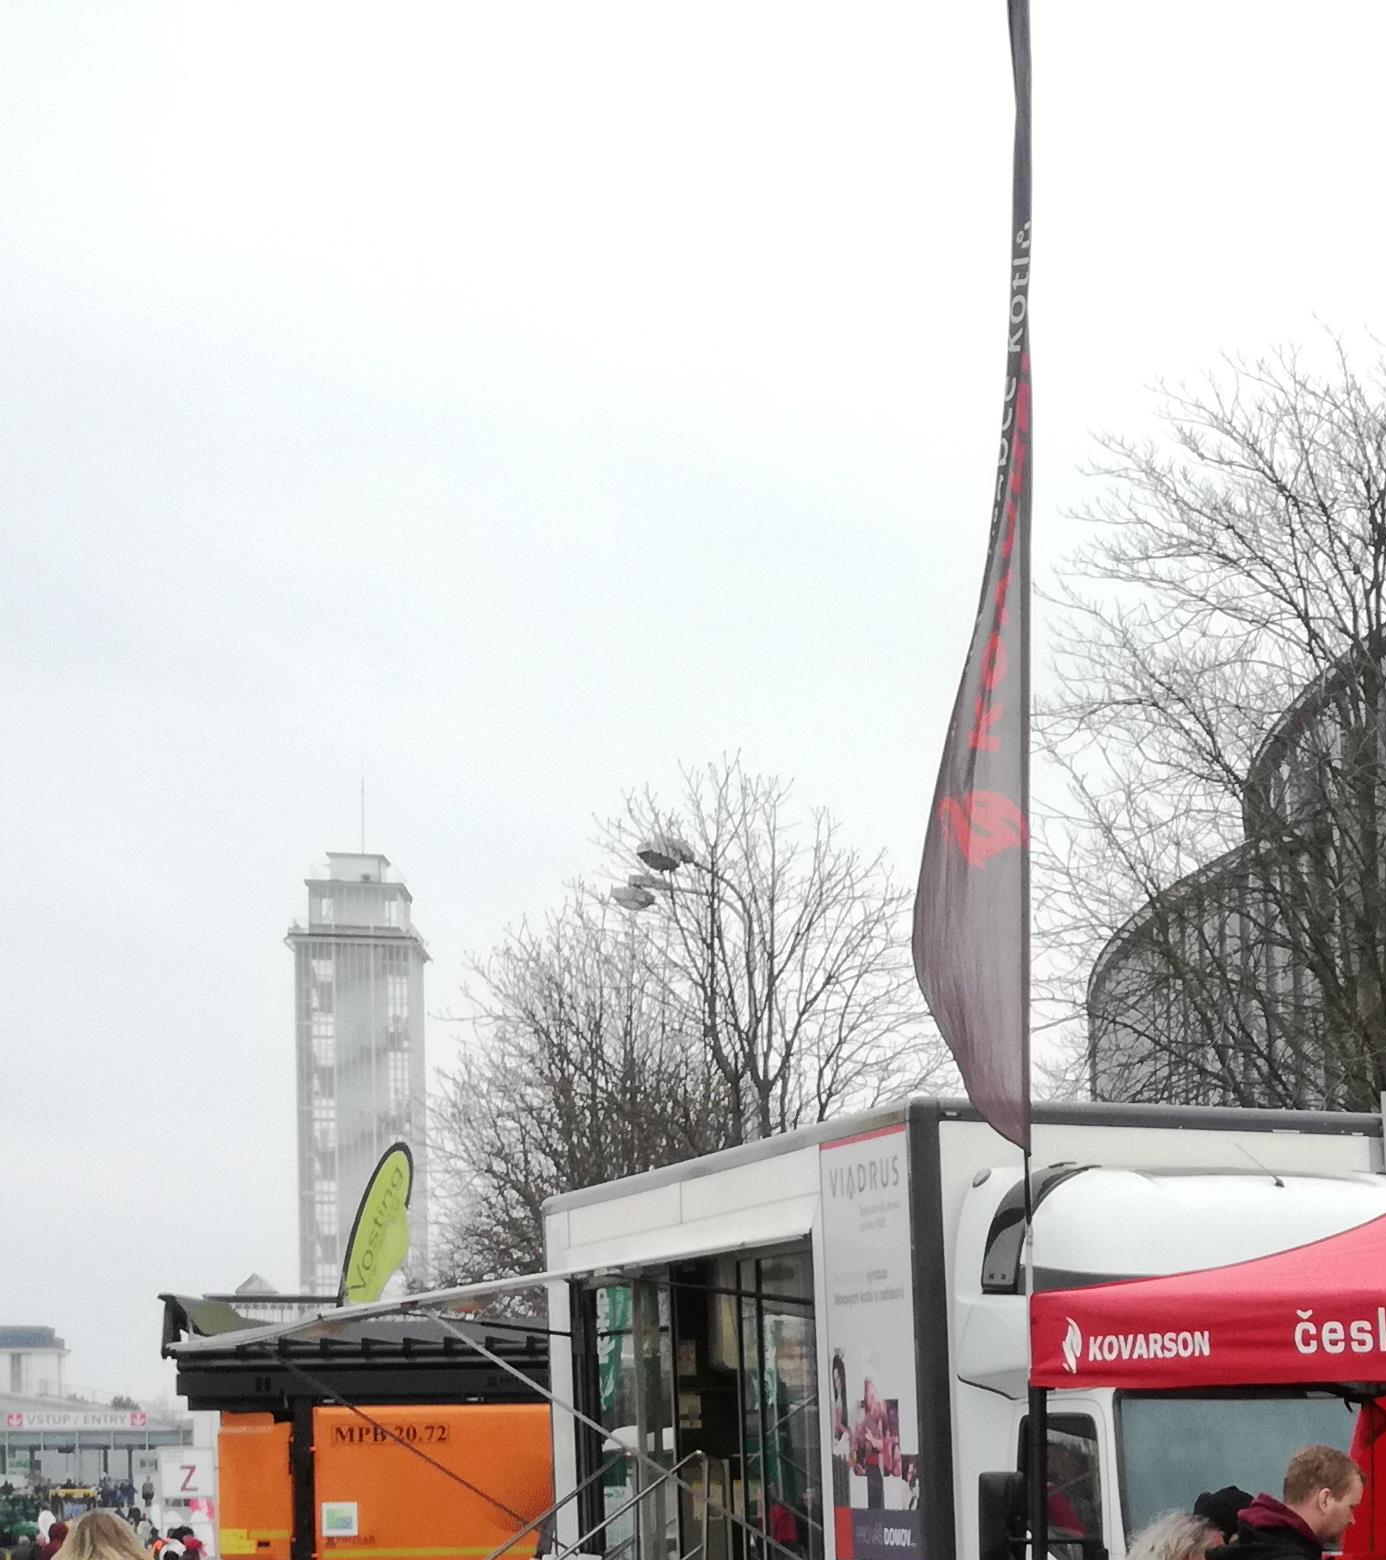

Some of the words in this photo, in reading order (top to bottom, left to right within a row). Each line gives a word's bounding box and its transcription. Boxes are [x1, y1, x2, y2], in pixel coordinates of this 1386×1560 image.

[829, 1155, 900, 1200] VIADRUS
[1087, 1330, 1211, 1363] KOVARSON
[27, 1414, 72, 1425] VSTUP
[83, 1413, 127, 1425] ENTRY
[180, 1465, 199, 1492] Z
